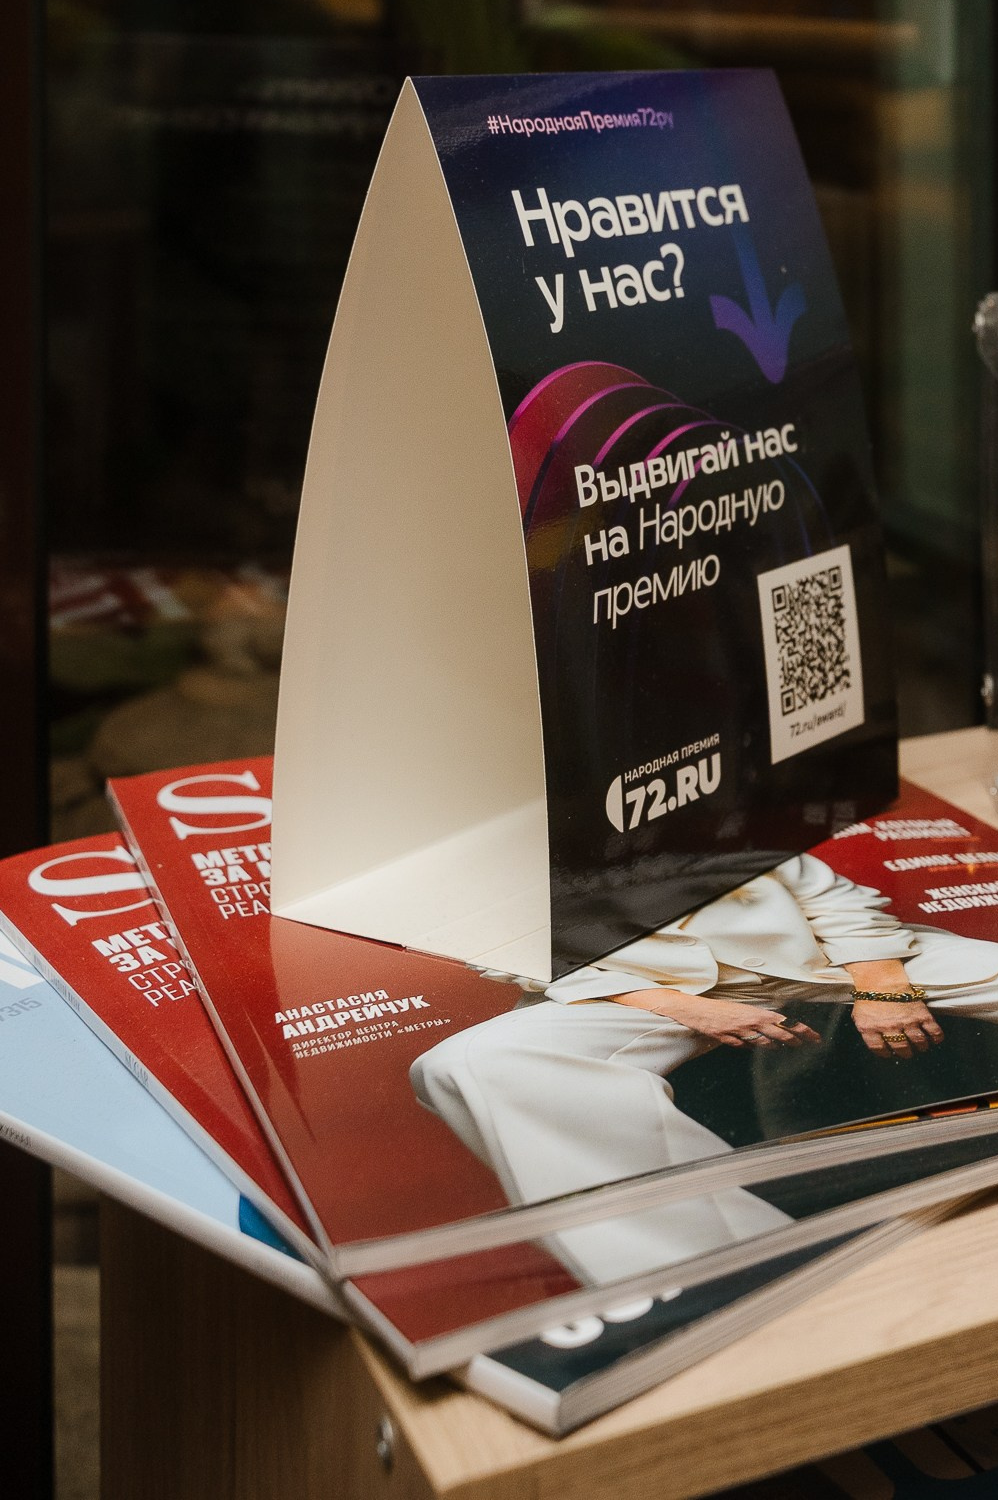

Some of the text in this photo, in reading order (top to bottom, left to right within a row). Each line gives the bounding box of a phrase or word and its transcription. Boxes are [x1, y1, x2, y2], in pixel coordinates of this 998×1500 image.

[511, 184, 749, 258] Нравится
[536, 242, 685, 333] у нас?
[574, 423, 798, 508] Выдвигай нас
[584, 480, 785, 566] на Народную
[592, 554, 720, 629] премию
[624, 733, 720, 784] НАРОДНАЯ ПРЕМИЯ
[625, 752, 721, 830] 72.RU
[200, 864, 252, 886] ЗА
[91, 921, 168, 957] МЕТ
[109, 945, 168, 972] ЗА
[128, 960, 186, 990] СТР
[275, 989, 390, 1024] АНАСТАСИЯ
[282, 995, 431, 1039] АНДРЕЙЧУК
[291, 1020, 399, 1052] ДИРЕКТОР ЦЕНТРА
[294, 1017, 451, 1060] НЕДВИЖИМОСТИ «МЕТРЫ»
